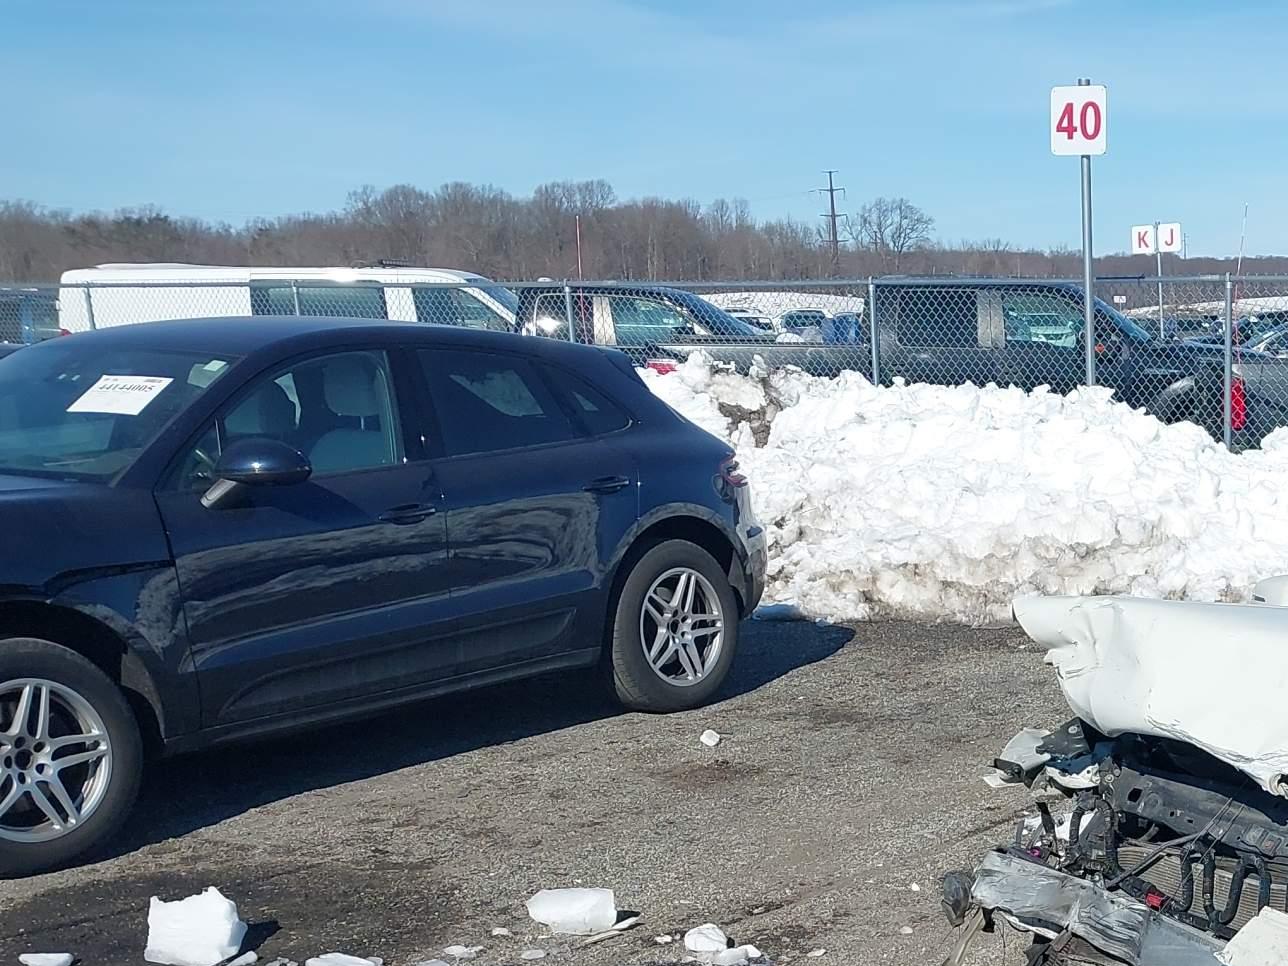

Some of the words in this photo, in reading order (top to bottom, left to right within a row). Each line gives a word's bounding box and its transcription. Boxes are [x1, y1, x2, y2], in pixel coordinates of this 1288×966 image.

[1056, 101, 1101, 140] 40
[1137, 230, 1149, 249] K
[1164, 228, 1174, 247] J
